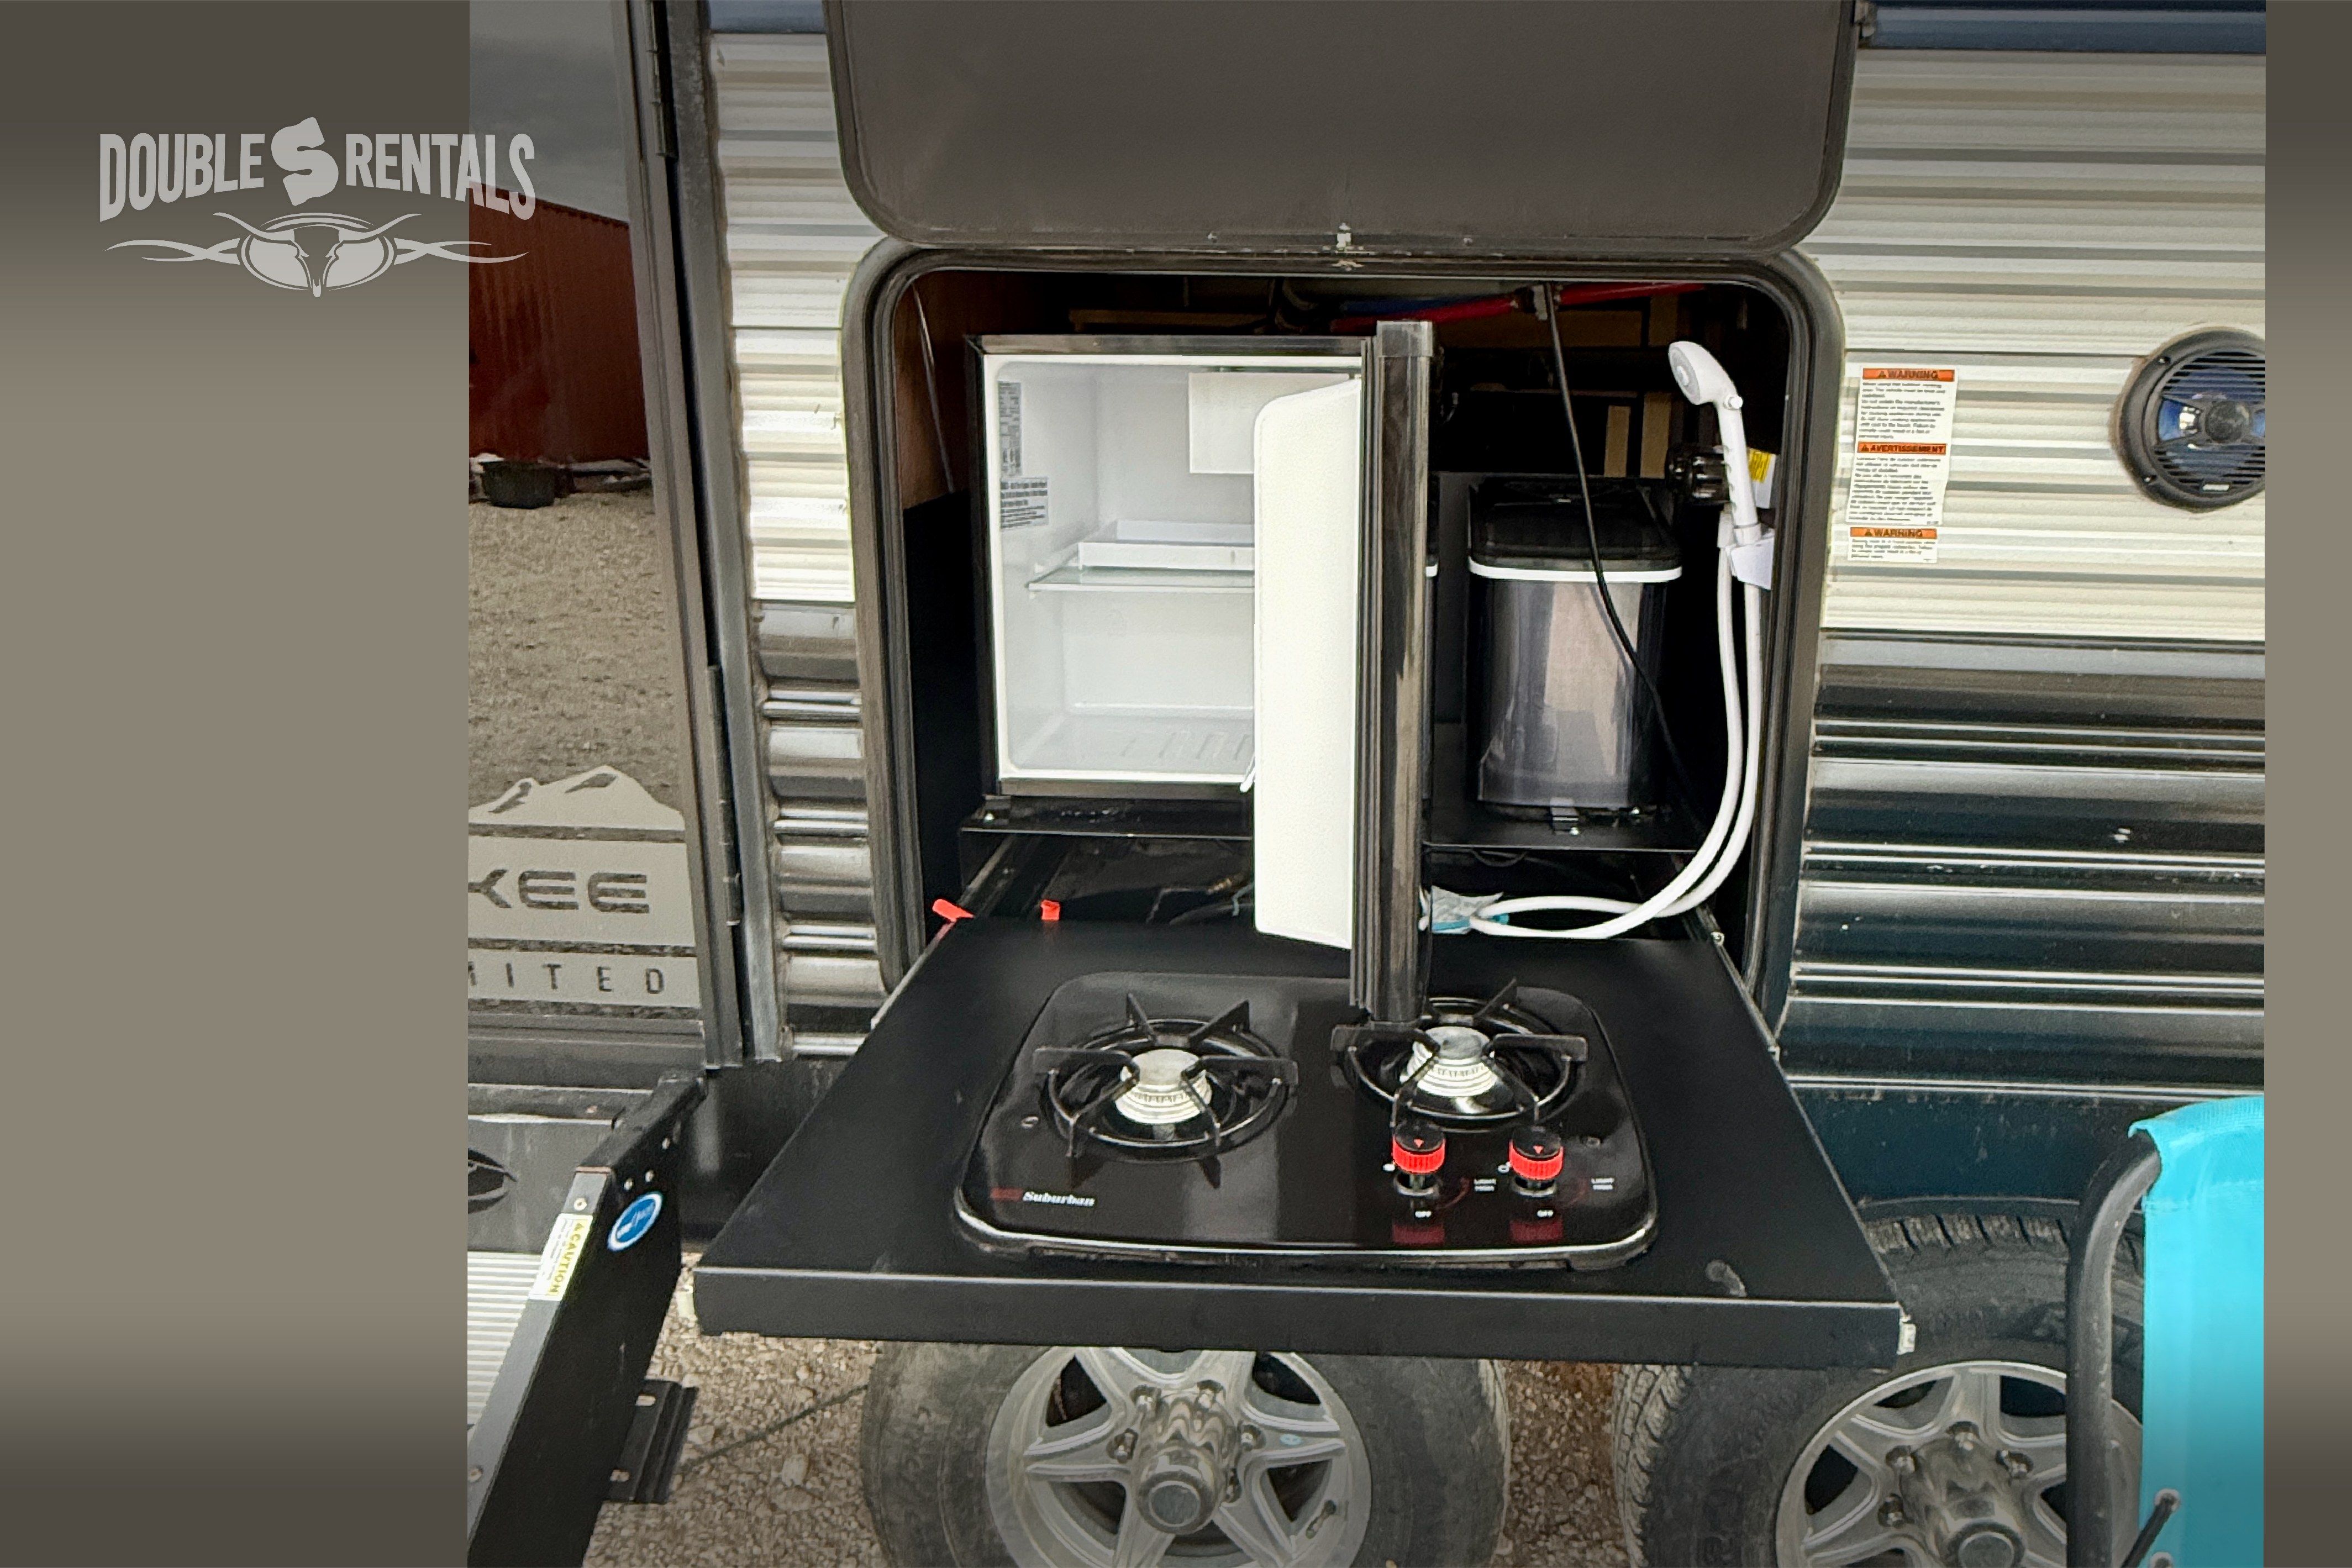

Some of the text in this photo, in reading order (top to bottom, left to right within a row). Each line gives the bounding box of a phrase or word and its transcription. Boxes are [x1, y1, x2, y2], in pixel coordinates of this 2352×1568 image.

[1888, 370, 1938, 379] WARNING
[1871, 444, 1943, 453] AVERTISSEMENT
[1874, 528, 1923, 537] WARNING
[1023, 1191, 1096, 1207] Suburban
[547, 1233, 581, 1294] CAUTION
